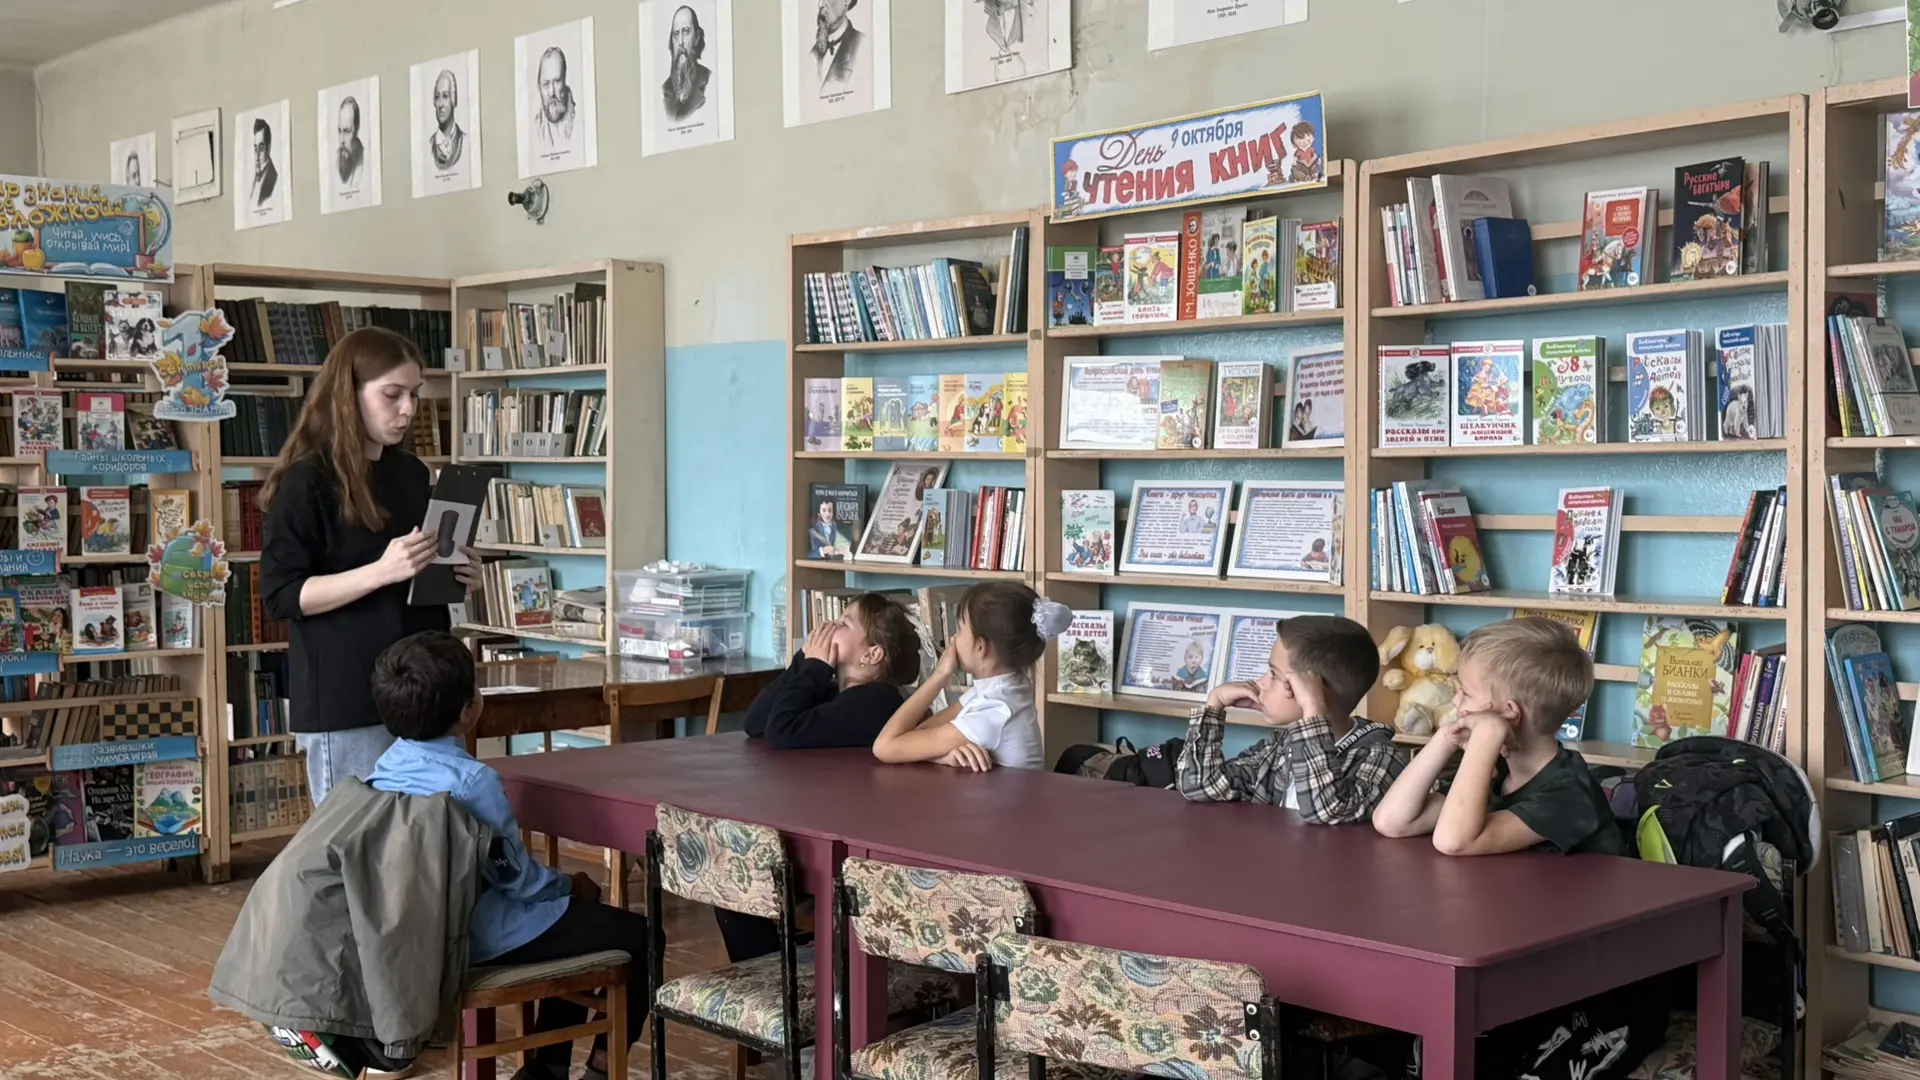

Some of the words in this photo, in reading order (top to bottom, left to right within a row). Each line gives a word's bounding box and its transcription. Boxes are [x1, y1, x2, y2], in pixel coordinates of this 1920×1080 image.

[1171, 128, 1179, 149] 9
[1181, 118, 1244, 146] октября
[1097, 130, 1167, 172] День
[52, 225, 87, 240] Читай,
[47, 239, 100, 252] открывай
[103, 241, 130, 254] мир!
[1187, 238, 1198, 297] ЗОЩЕНКО
[74, 452, 110, 462] Тайны
[111, 453, 165, 463] школьных
[92, 462, 148, 473] коридоров
[1071, 622, 1107, 630] АССКАЗЫ
[1662, 664, 1709, 678] БИАНКИ
[91, 742, 157, 755] Развивашки:
[91, 754, 130, 765] учимся
[131, 752, 159, 762] играя
[145, 770, 195, 779] ГЕОГРАФИЯ
[60, 848, 102, 865] Наука
[126, 844, 145, 857] это
[149, 838, 196, 854] весело!
